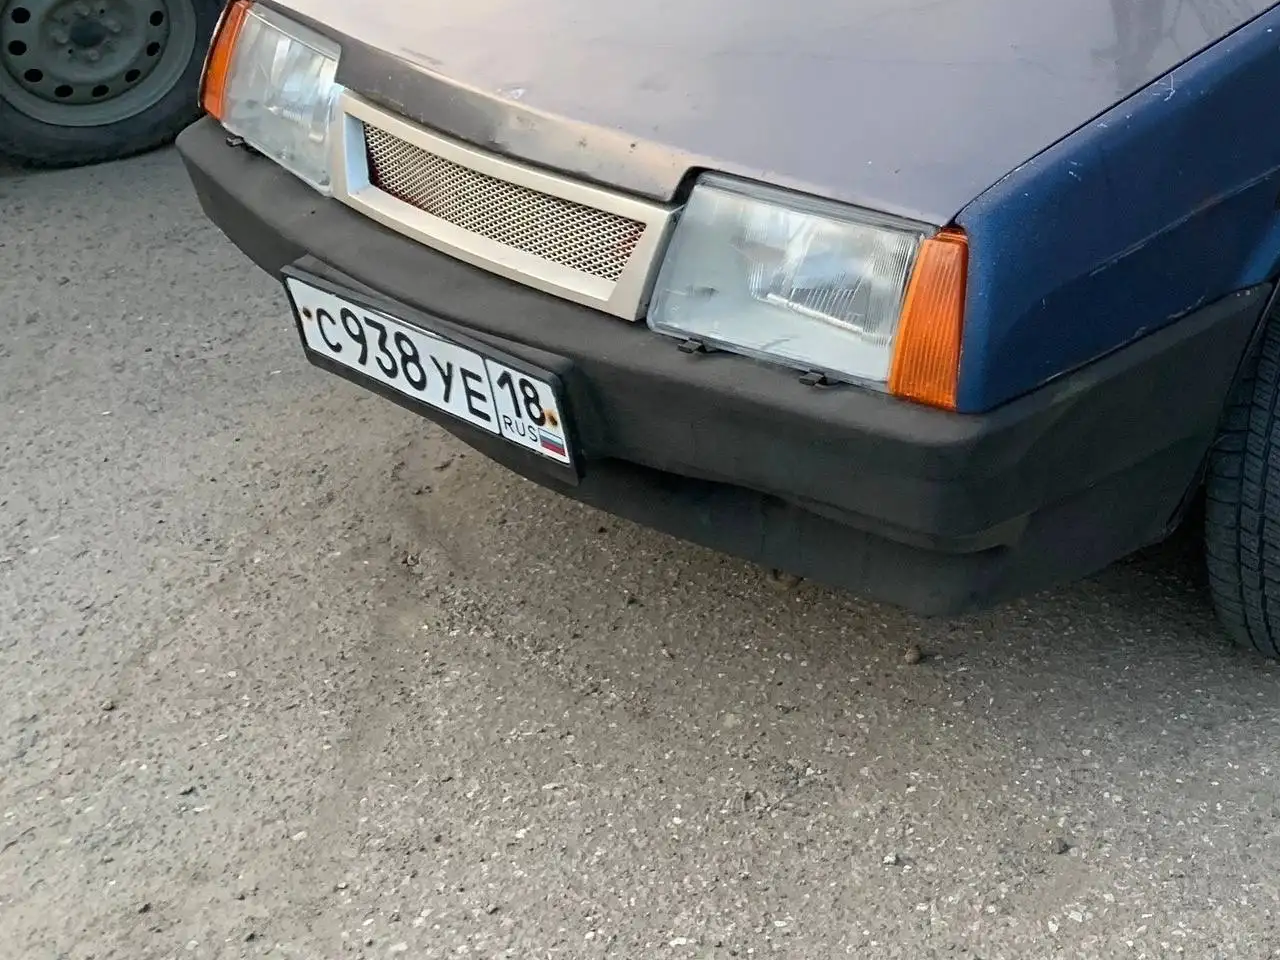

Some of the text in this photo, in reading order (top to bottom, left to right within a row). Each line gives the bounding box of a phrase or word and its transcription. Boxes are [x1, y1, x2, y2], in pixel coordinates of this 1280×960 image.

[316, 307, 546, 427] С938УЕ 18
[502, 414, 539, 443] RUS
